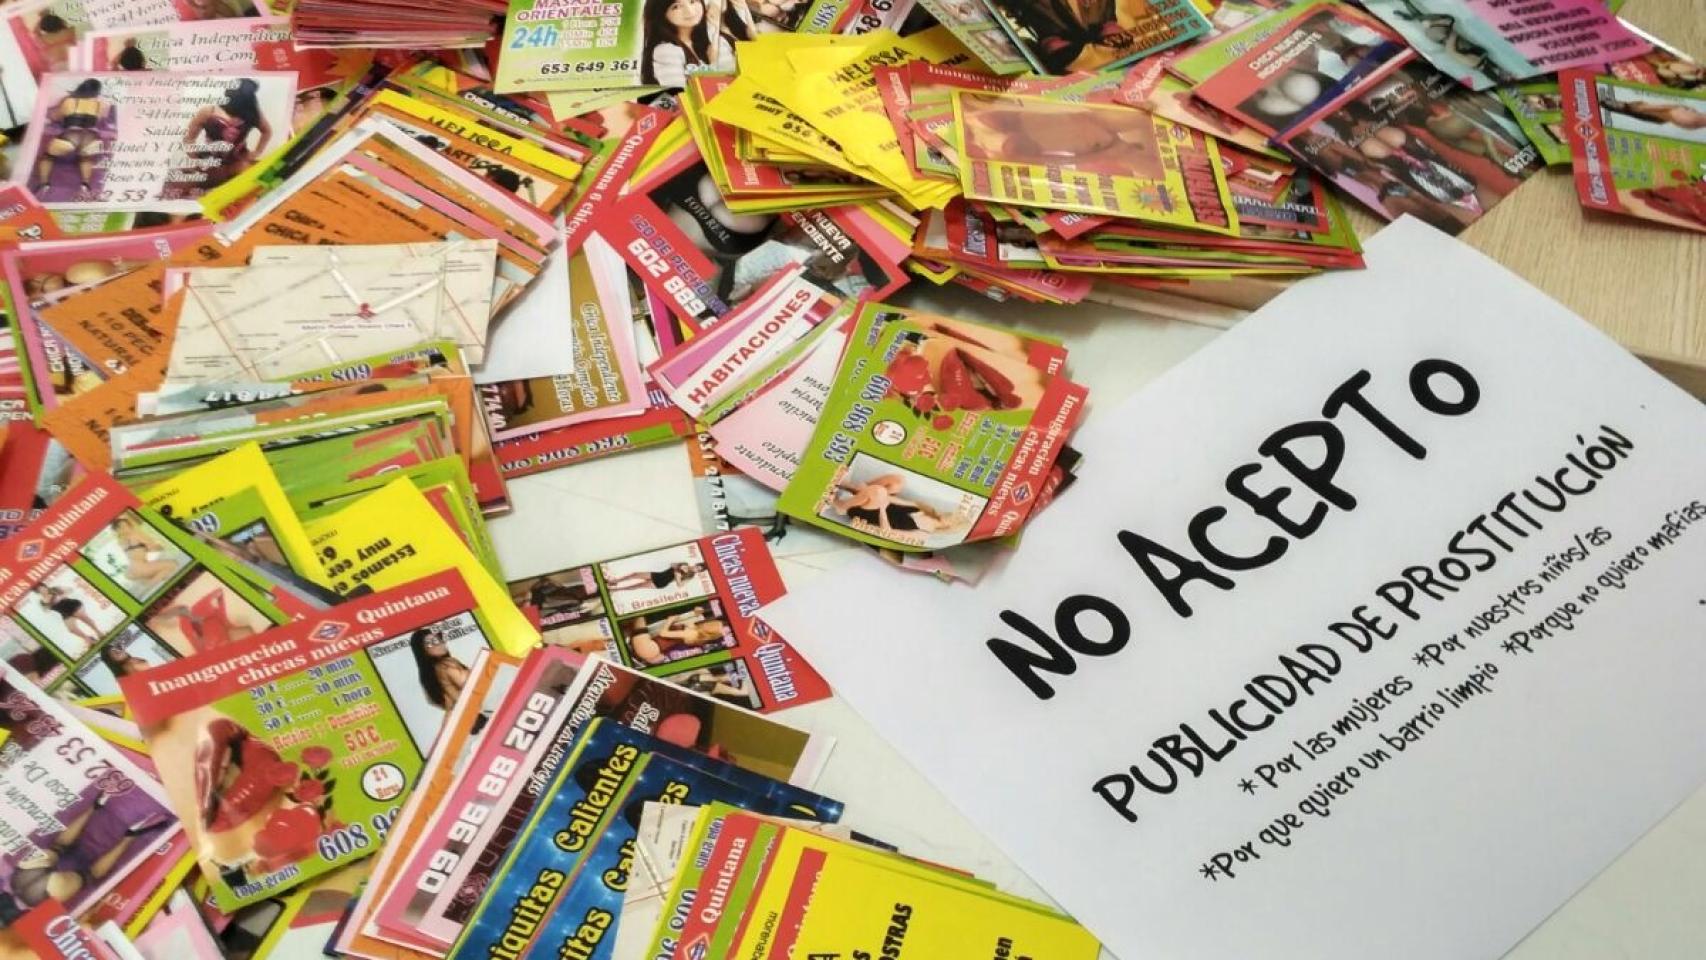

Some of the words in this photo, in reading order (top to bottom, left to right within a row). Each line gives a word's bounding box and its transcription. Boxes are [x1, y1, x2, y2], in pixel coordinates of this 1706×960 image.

[510, 26, 559, 50] 24h
[516, 3, 623, 22] ORIENTALES
[540, 62, 572, 75] 653
[574, 61, 606, 74] 649
[609, 59, 641, 73] 361
[600, 132, 644, 194] Quintana
[627, 234, 664, 278] 602
[663, 279, 707, 324] 889
[687, 288, 812, 405] HABITACIONES
[862, 373, 893, 402] 608
[843, 403, 874, 433] 968
[1027, 389, 1079, 481] Inauguración
[823, 432, 857, 463] 593
[1012, 428, 1041, 474] chicas
[41, 486, 108, 540] Quintana
[986, 469, 1018, 519] nuevas
[25, 537, 78, 583] nuevas
[348, 542, 417, 585] Estamos
[355, 536, 392, 562] muy
[147, 638, 298, 697] Inauguración
[355, 586, 450, 625] Quintana
[711, 531, 750, 577] Chicas
[751, 640, 799, 704] Quintana
[237, 654, 307, 687] chicas
[311, 626, 385, 662] nuevas
[986, 595, 1131, 700] NO
[1255, 754, 1302, 788] Por
[1301, 732, 1337, 760] las
[1333, 675, 1412, 735] mujeres
[1464, 579, 1543, 639] nuestros
[1539, 526, 1612, 582] niños/as
[503, 690, 556, 753] 602
[1092, 644, 1341, 822] PUBLICIDAD
[1328, 606, 1398, 653] DE
[1259, 814, 1304, 846] que
[1299, 766, 1361, 817] quiero
[1359, 749, 1391, 771] un
[1390, 703, 1444, 751] barrio
[1437, 663, 1498, 709] limpio
[1578, 585, 1599, 605] no
[1598, 545, 1650, 589] quiero
[477, 753, 518, 798] 88
[318, 828, 369, 862] 608
[448, 803, 489, 846] 96
[417, 849, 459, 895] 60
[489, 868, 565, 960] iquitas
[555, 744, 638, 851] Calientes
[701, 836, 747, 925] Quintana
